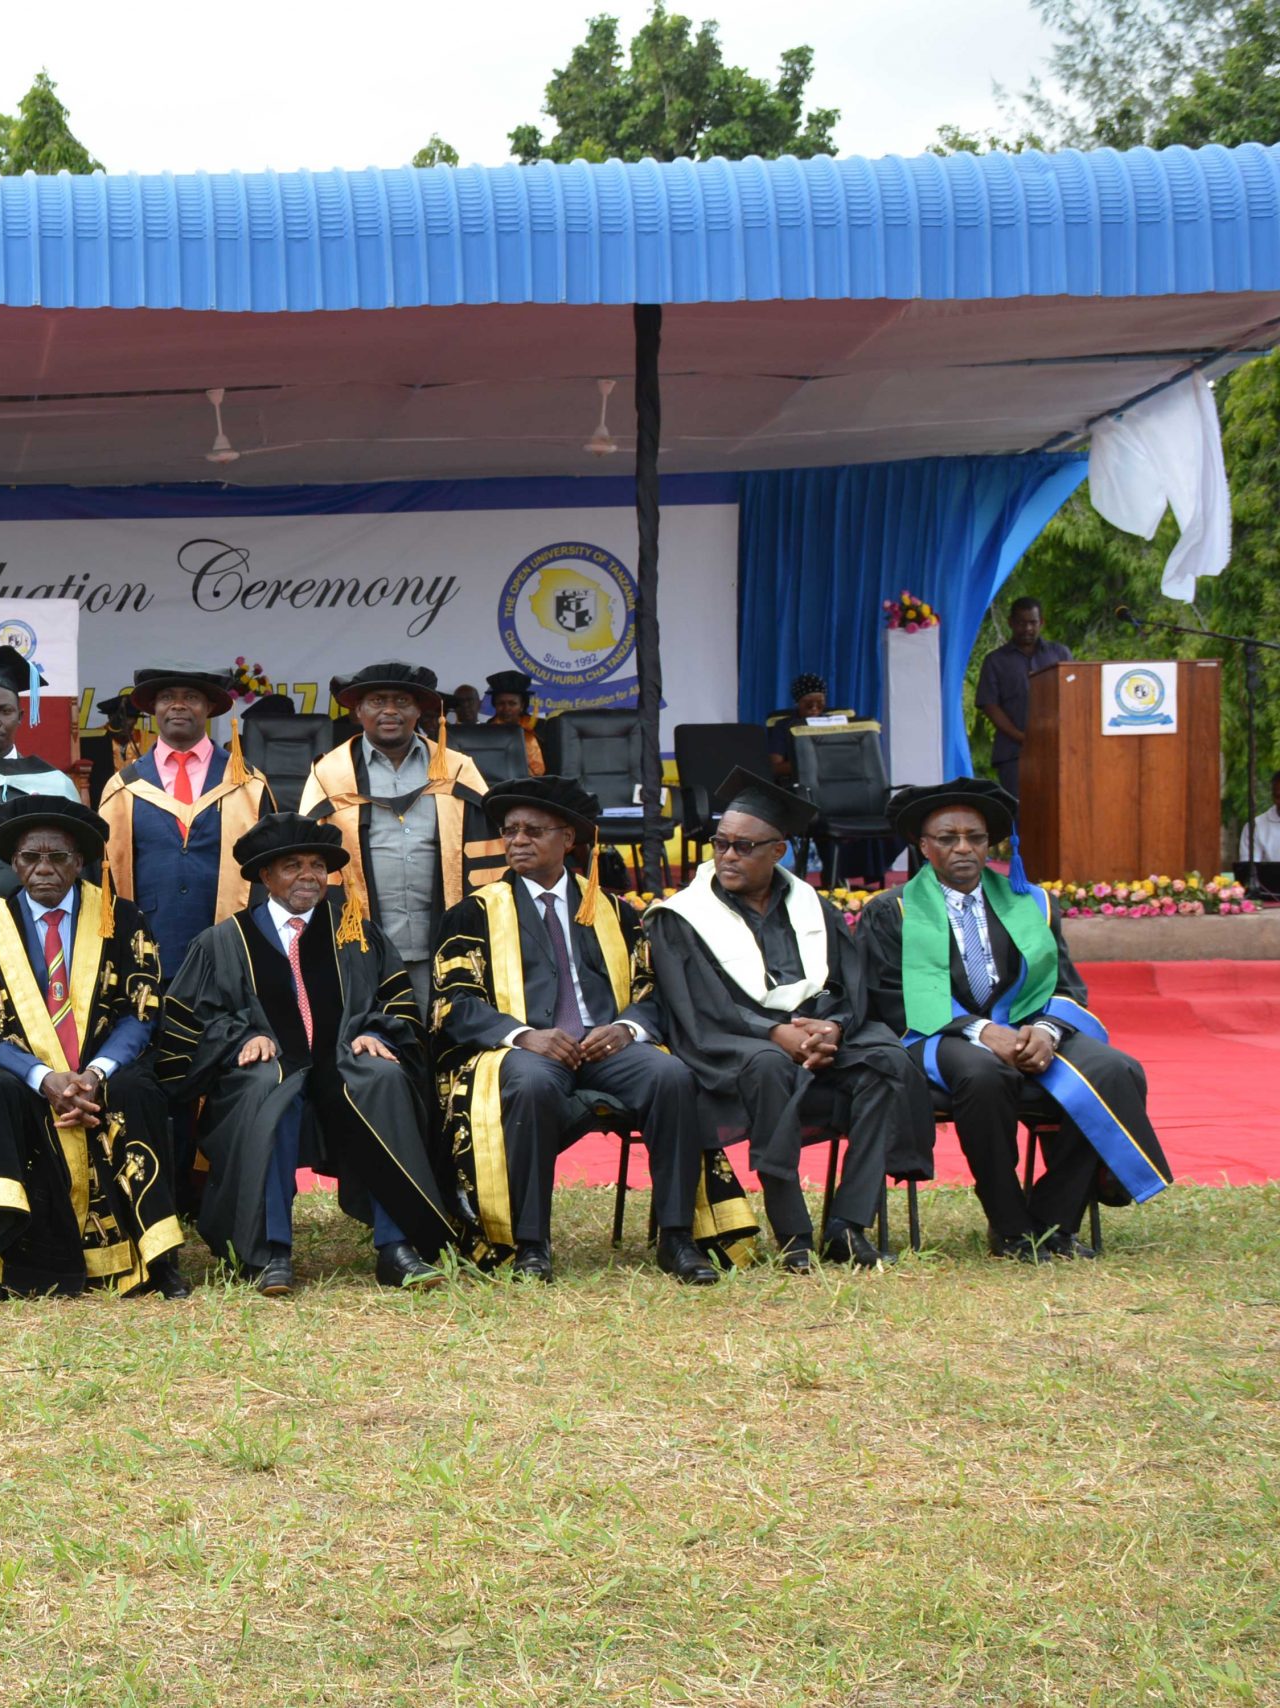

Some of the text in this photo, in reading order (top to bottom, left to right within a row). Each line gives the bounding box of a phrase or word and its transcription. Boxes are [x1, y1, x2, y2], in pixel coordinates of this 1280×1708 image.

[177, 538, 462, 638] Ceremony
[504, 545, 637, 618] THE OPEN UNIVERSITY OF TANZANIA
[504, 623, 637, 686] CHUO KIKUU HURIA CHA TANZANIA
[543, 653, 599, 670] Since 1992
